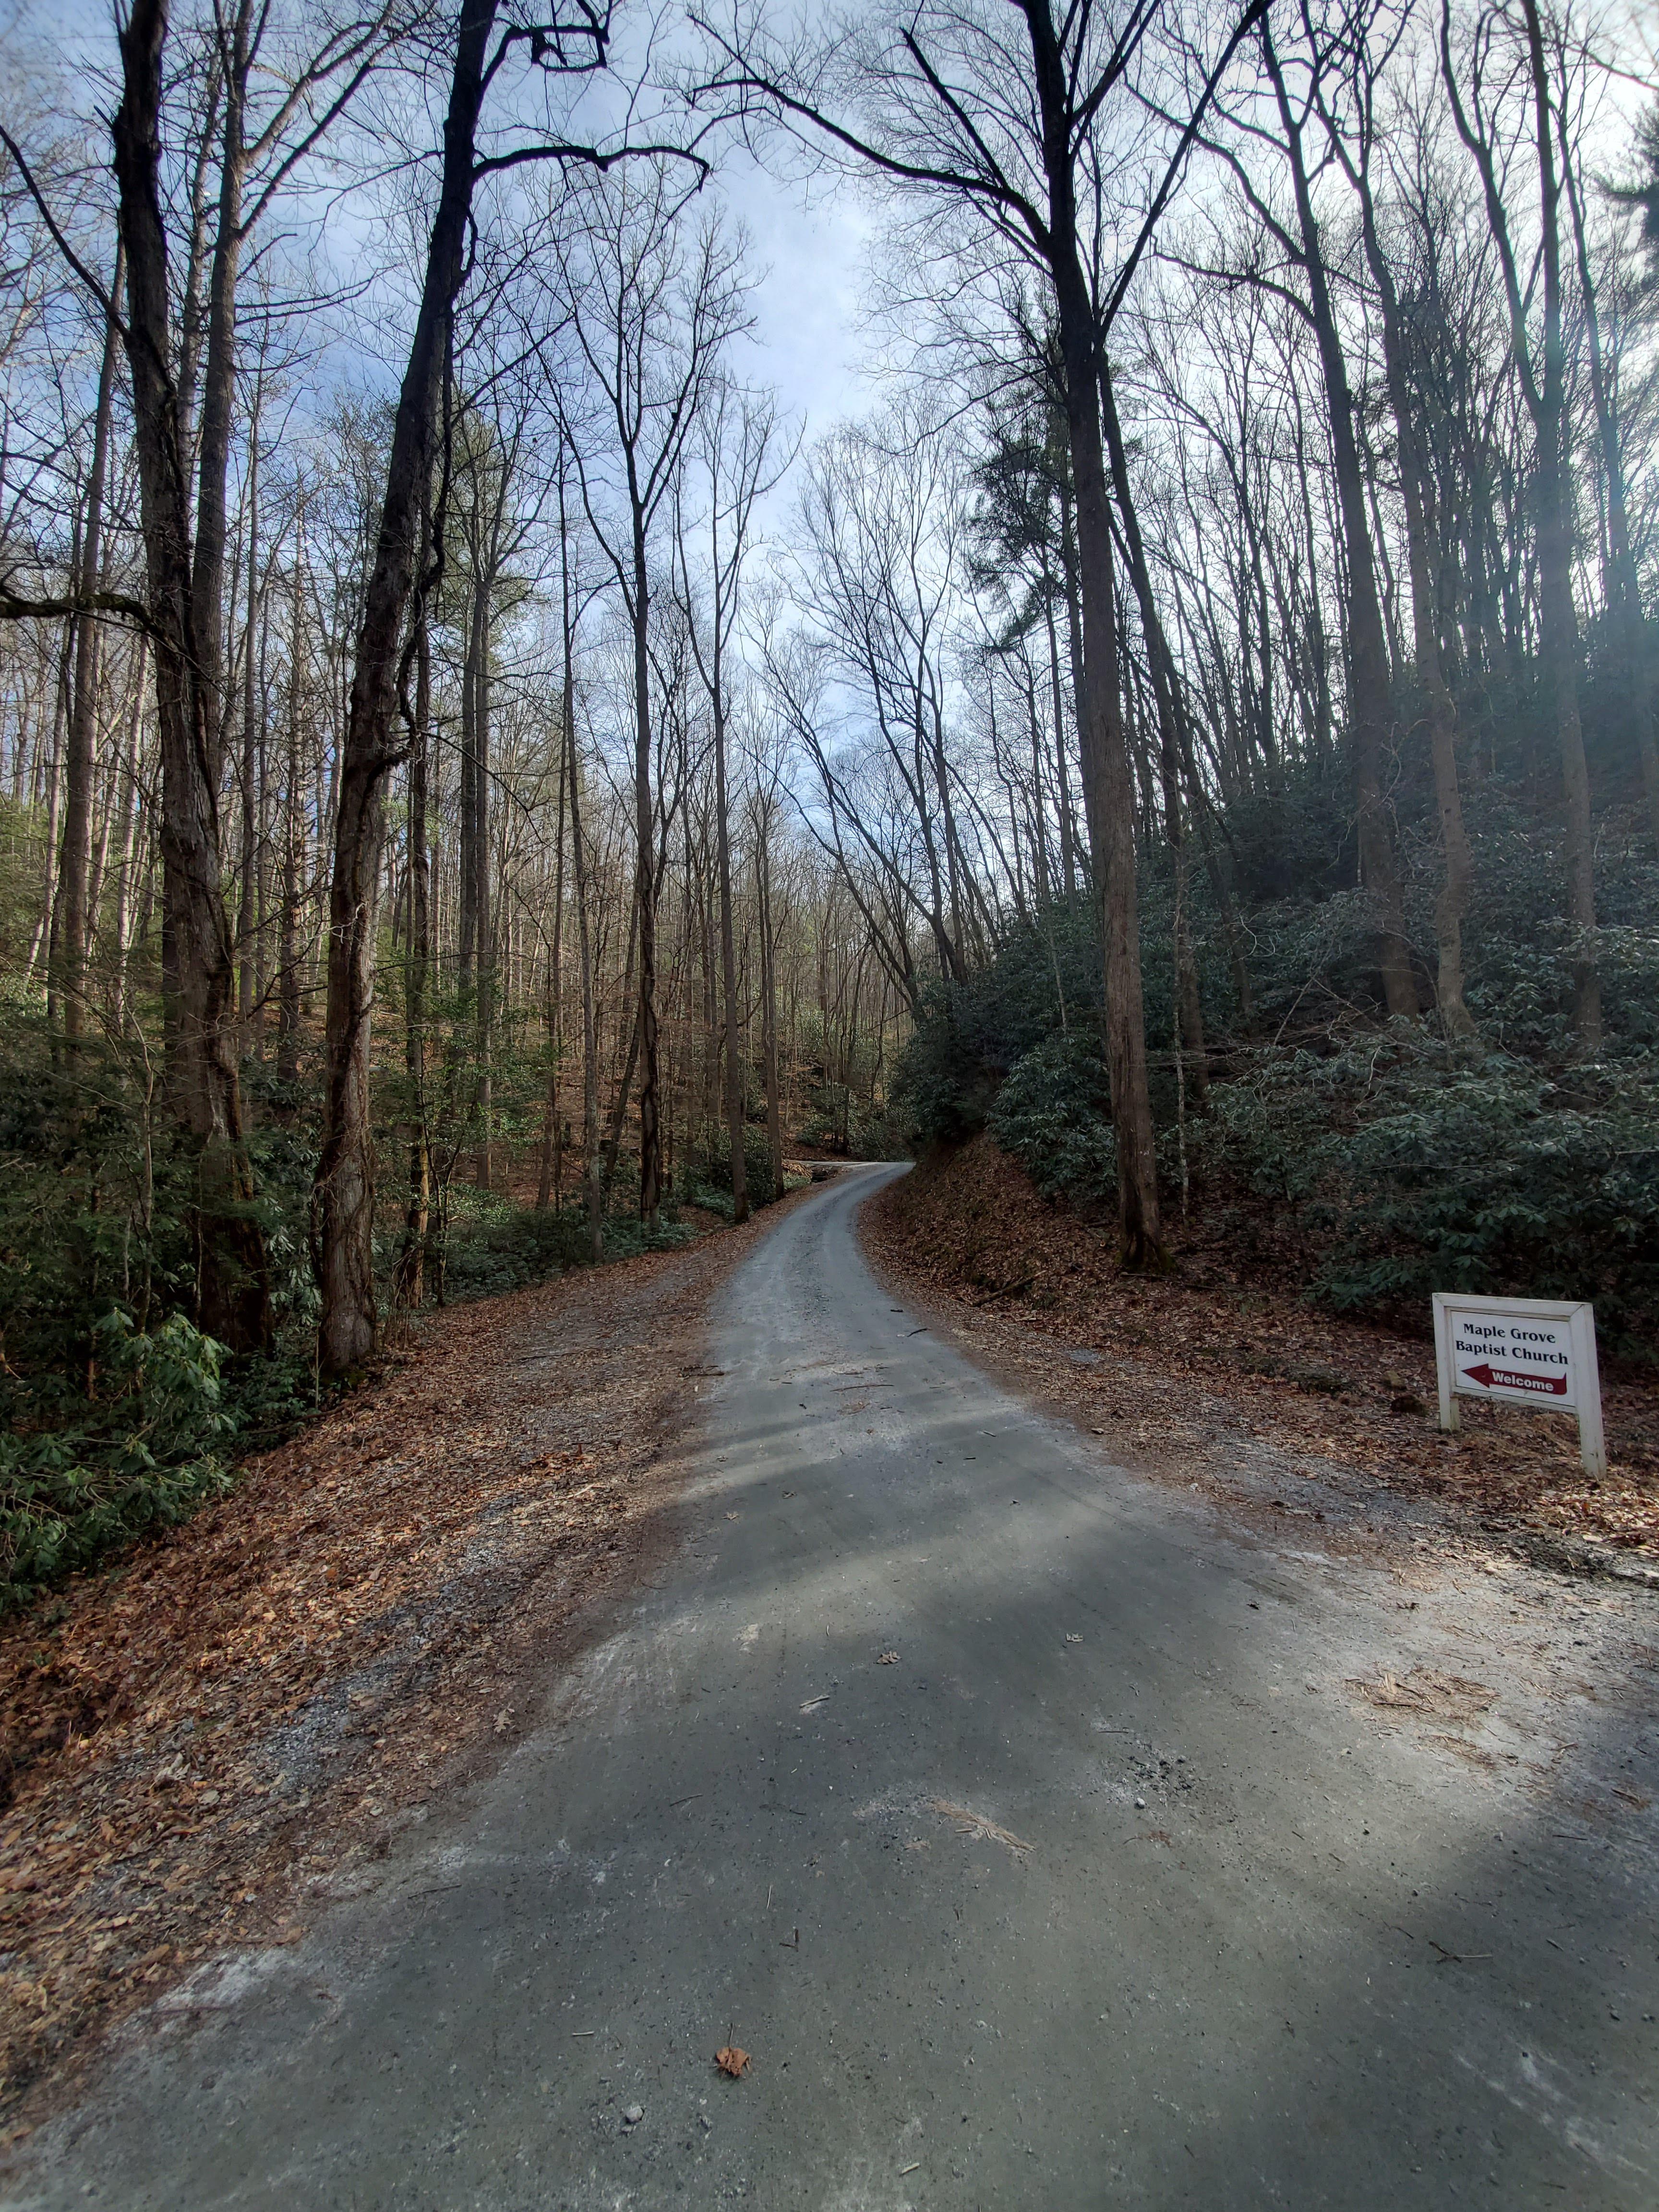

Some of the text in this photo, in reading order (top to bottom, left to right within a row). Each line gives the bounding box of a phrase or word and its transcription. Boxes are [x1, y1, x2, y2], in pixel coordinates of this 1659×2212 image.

[1464, 1323, 1556, 1343] Maple Grove
[1456, 1341, 1568, 1364] Baptist Church
[1492, 1371, 1554, 1392] Welcome
